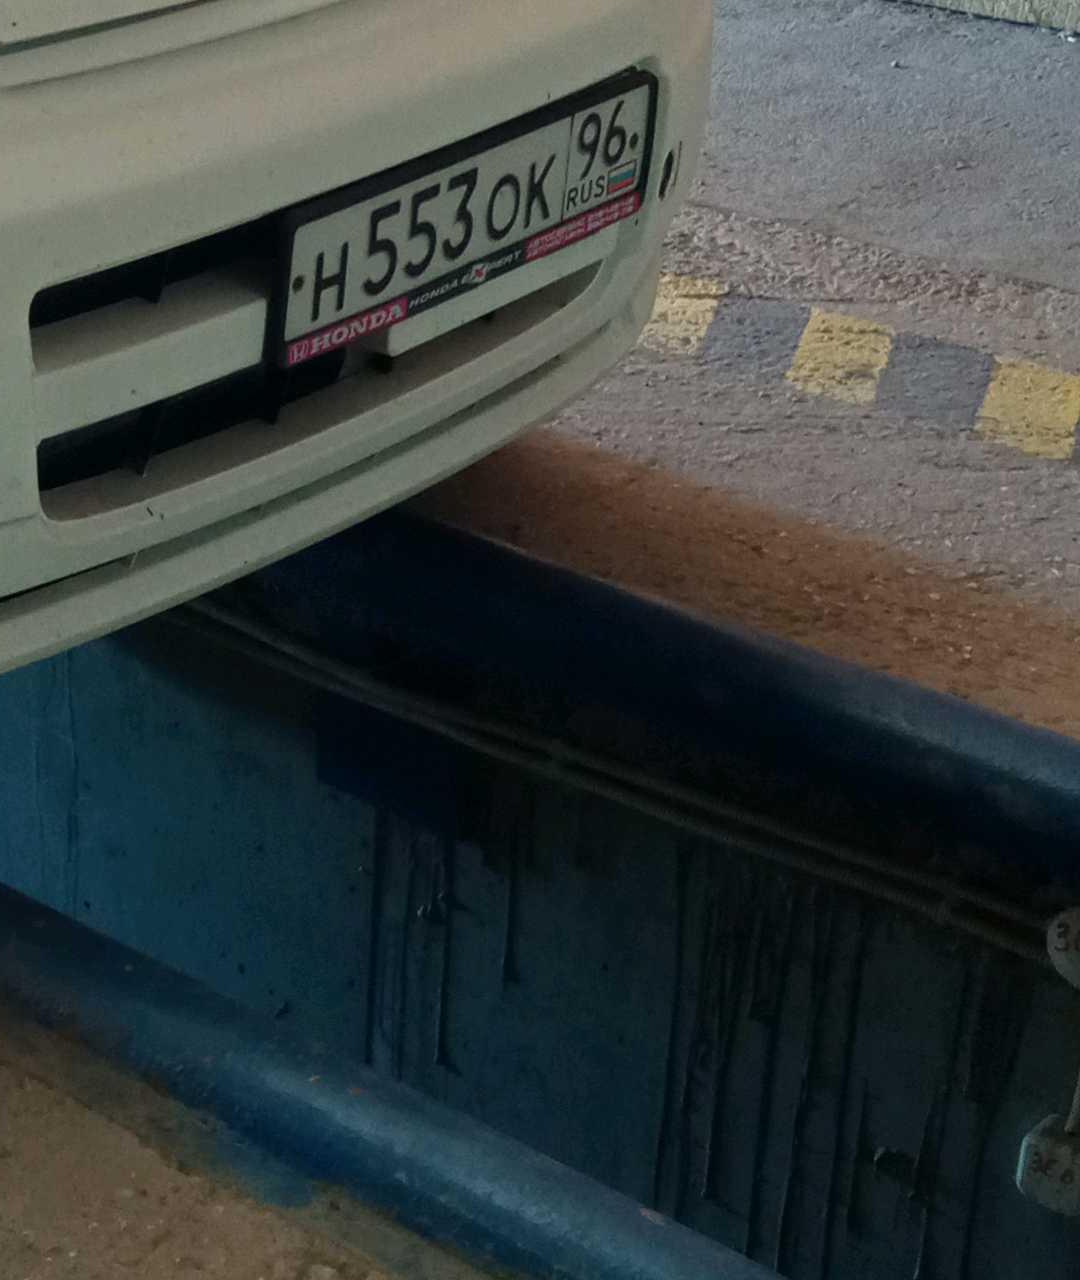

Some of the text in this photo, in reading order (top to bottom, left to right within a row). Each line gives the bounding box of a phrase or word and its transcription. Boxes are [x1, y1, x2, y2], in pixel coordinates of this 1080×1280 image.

[310, 153, 556, 323] Н553ОК
[578, 100, 627, 179] 96
[566, 173, 606, 213] RUS
[310, 302, 404, 355] HONDA
